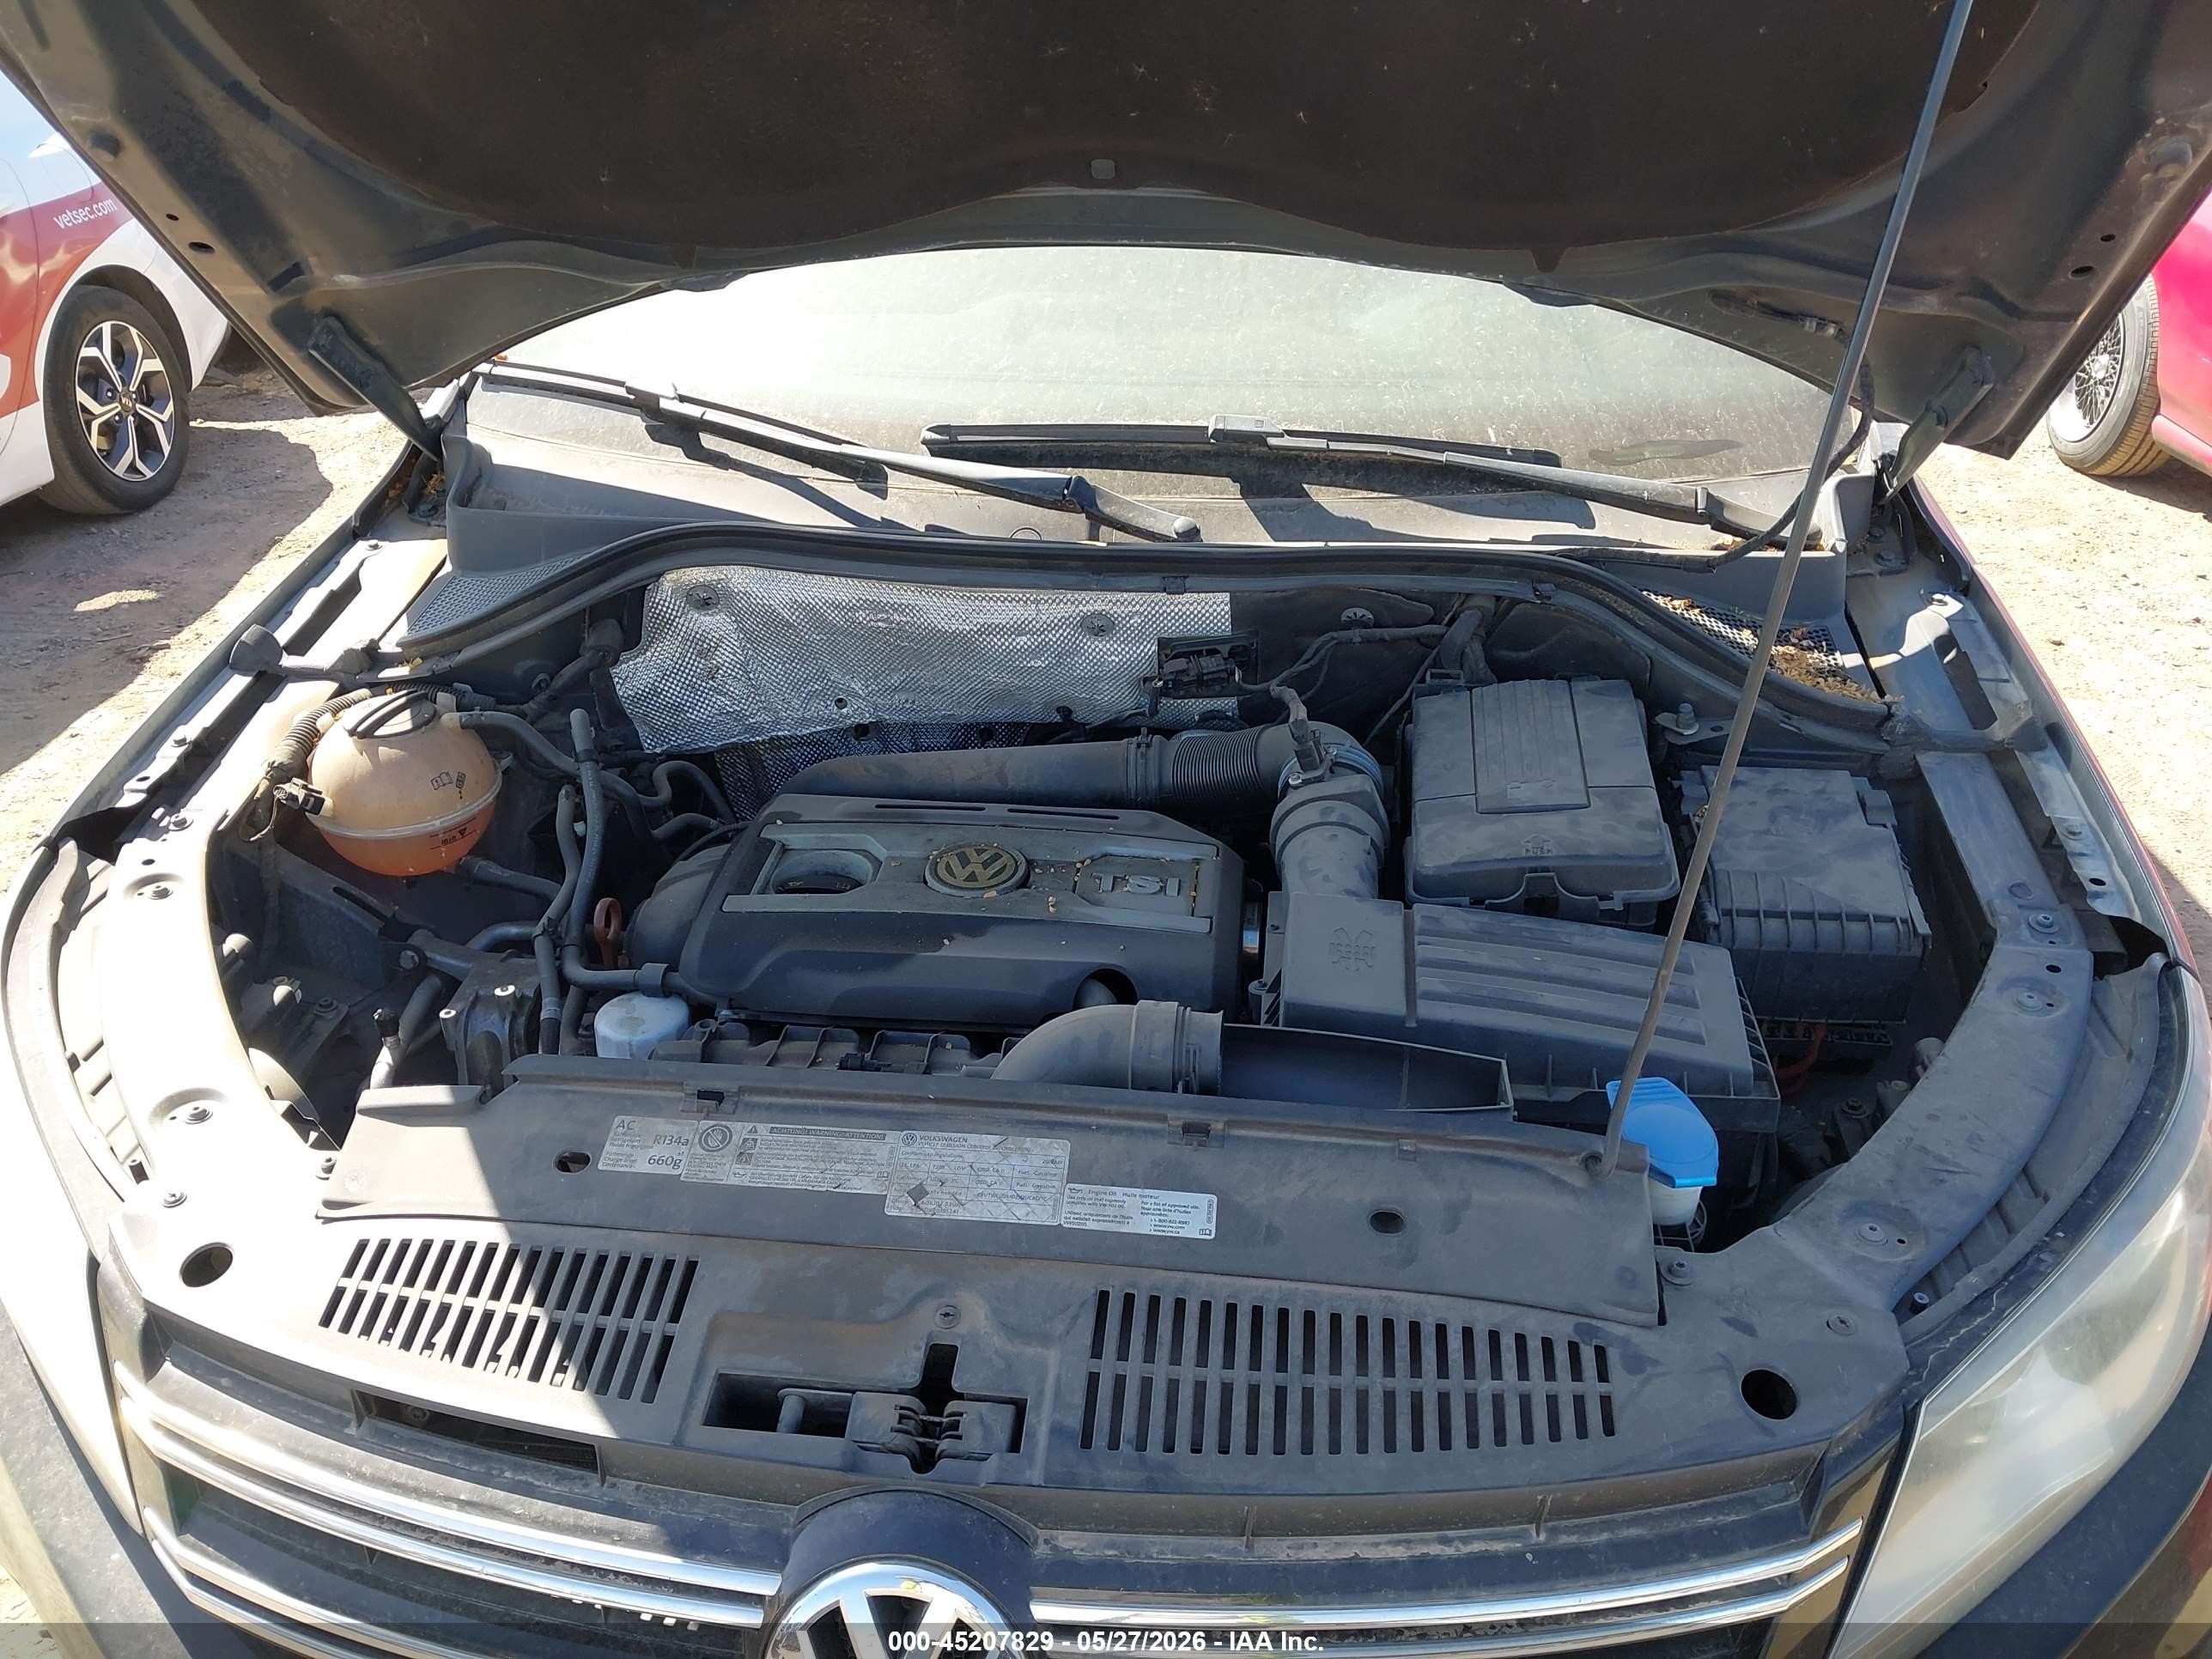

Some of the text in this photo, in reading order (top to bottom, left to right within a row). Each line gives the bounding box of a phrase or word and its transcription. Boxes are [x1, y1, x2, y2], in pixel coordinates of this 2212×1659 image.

[53, 199, 117, 228] vetsec.com
[1091, 871, 1181, 897] TSI
[616, 1120, 636, 1130] AC
[919, 1134, 968, 1144] VOLKSWAGEN
[647, 1154, 683, 1170] 660g
